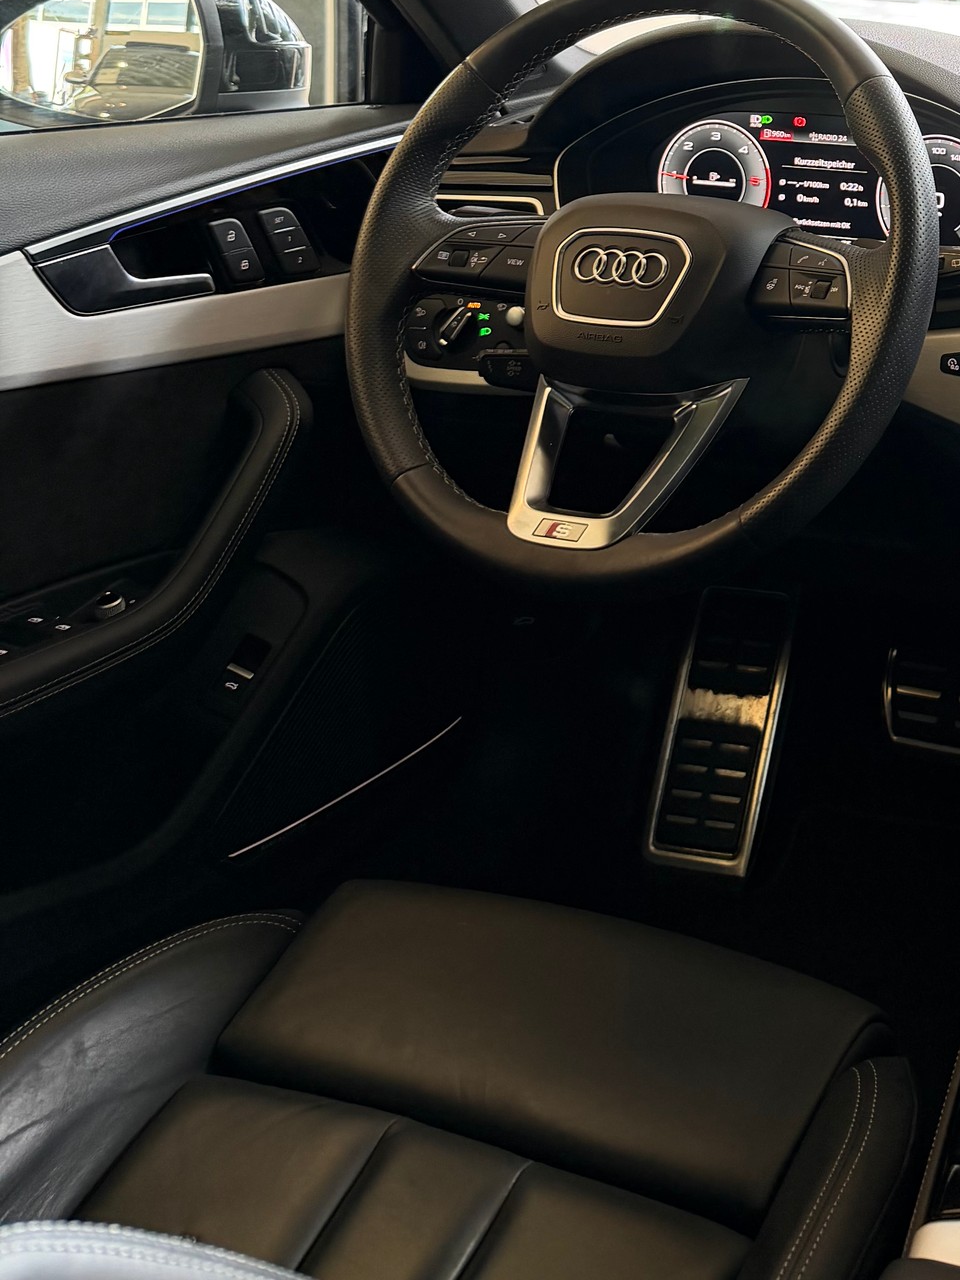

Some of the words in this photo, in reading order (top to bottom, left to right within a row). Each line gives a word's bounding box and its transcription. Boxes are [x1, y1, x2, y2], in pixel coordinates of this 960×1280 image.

[711, 132, 721, 141] 3
[818, 133, 837, 142] RADIO
[683, 141, 694, 151] 2
[738, 145, 748, 154] 4
[931, 147, 946, 155] 100
[793, 157, 856, 169] Kurzzeitspeicher
[507, 257, 524, 267] VIEW
[466, 301, 482, 309] AUTO
[576, 332, 623, 343] AIRBAG
